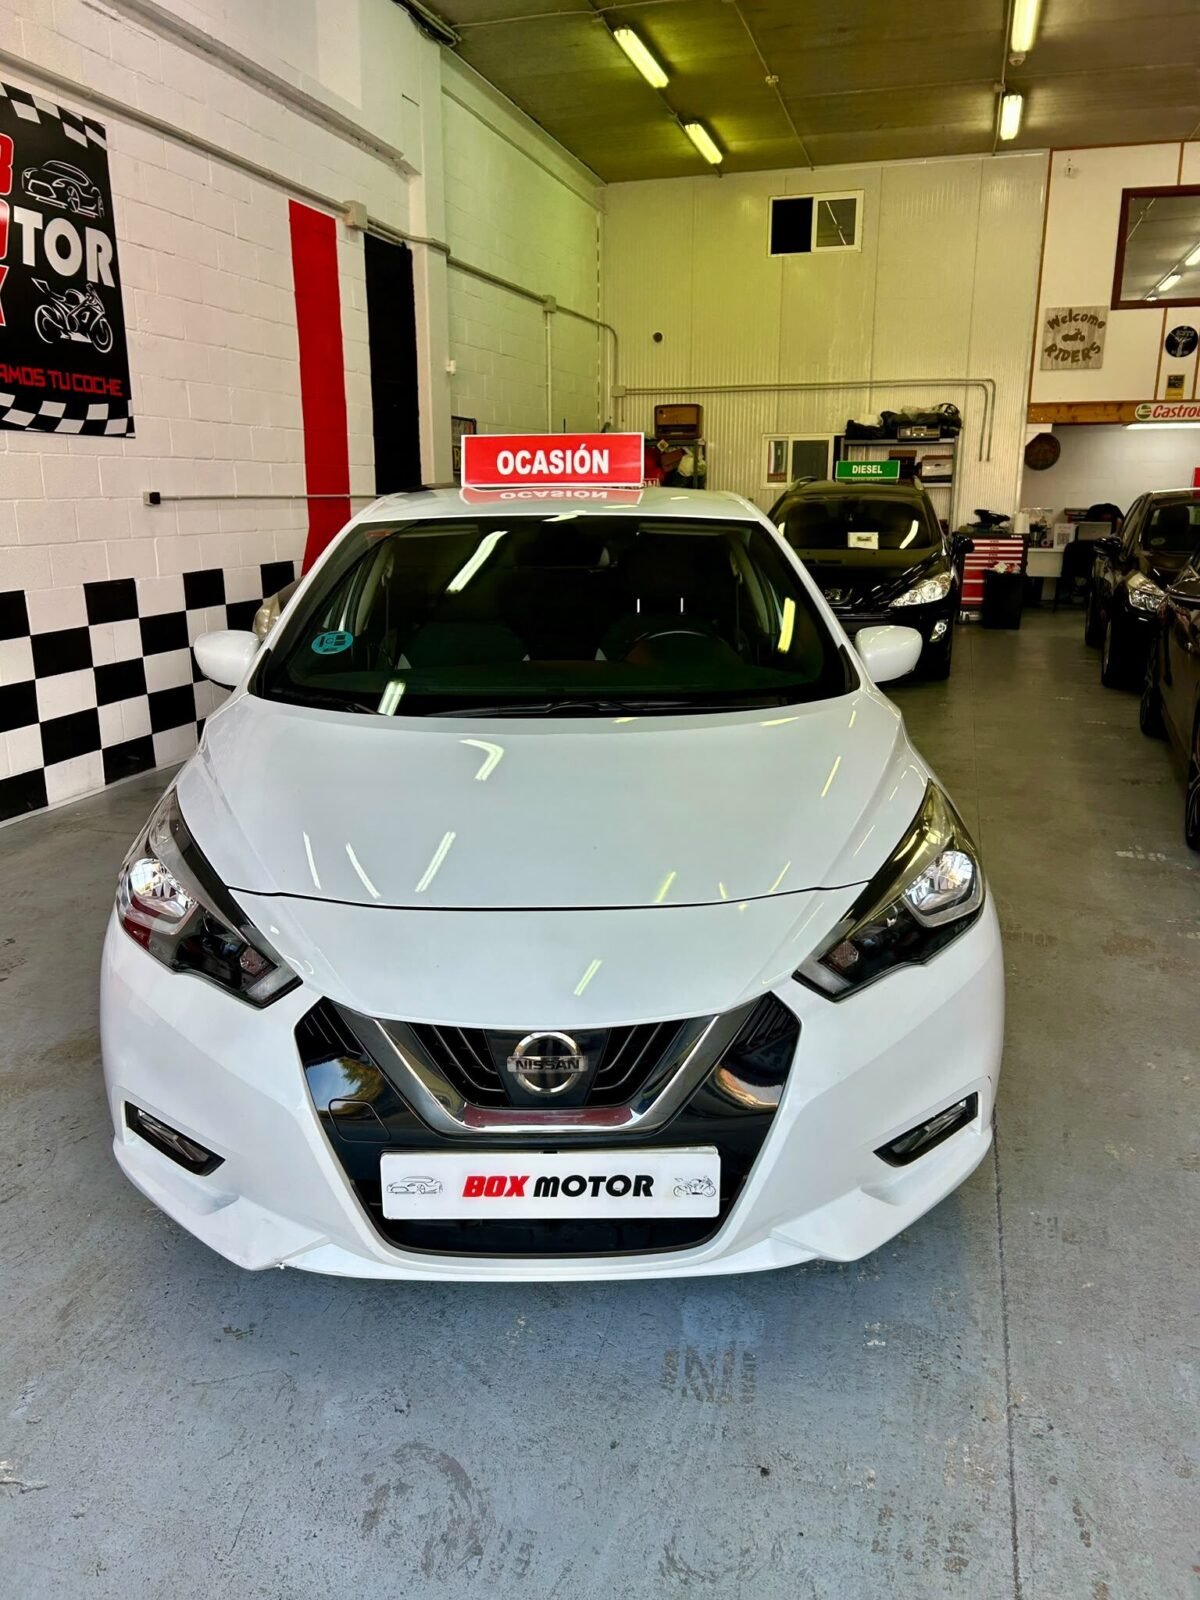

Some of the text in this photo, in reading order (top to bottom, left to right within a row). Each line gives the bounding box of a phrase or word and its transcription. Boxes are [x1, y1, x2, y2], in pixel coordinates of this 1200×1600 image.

[1047, 308, 1106, 330] Welcome
[1044, 341, 1102, 364] RIDERS
[47, 370, 71, 391] TU
[72, 373, 123, 397] COCHE
[496, 444, 610, 475] OCASIÓN
[852, 464, 883, 474] DIESEL
[515, 1058, 580, 1071] NISSAN
[462, 1174, 655, 1198] BOX MOTOR
